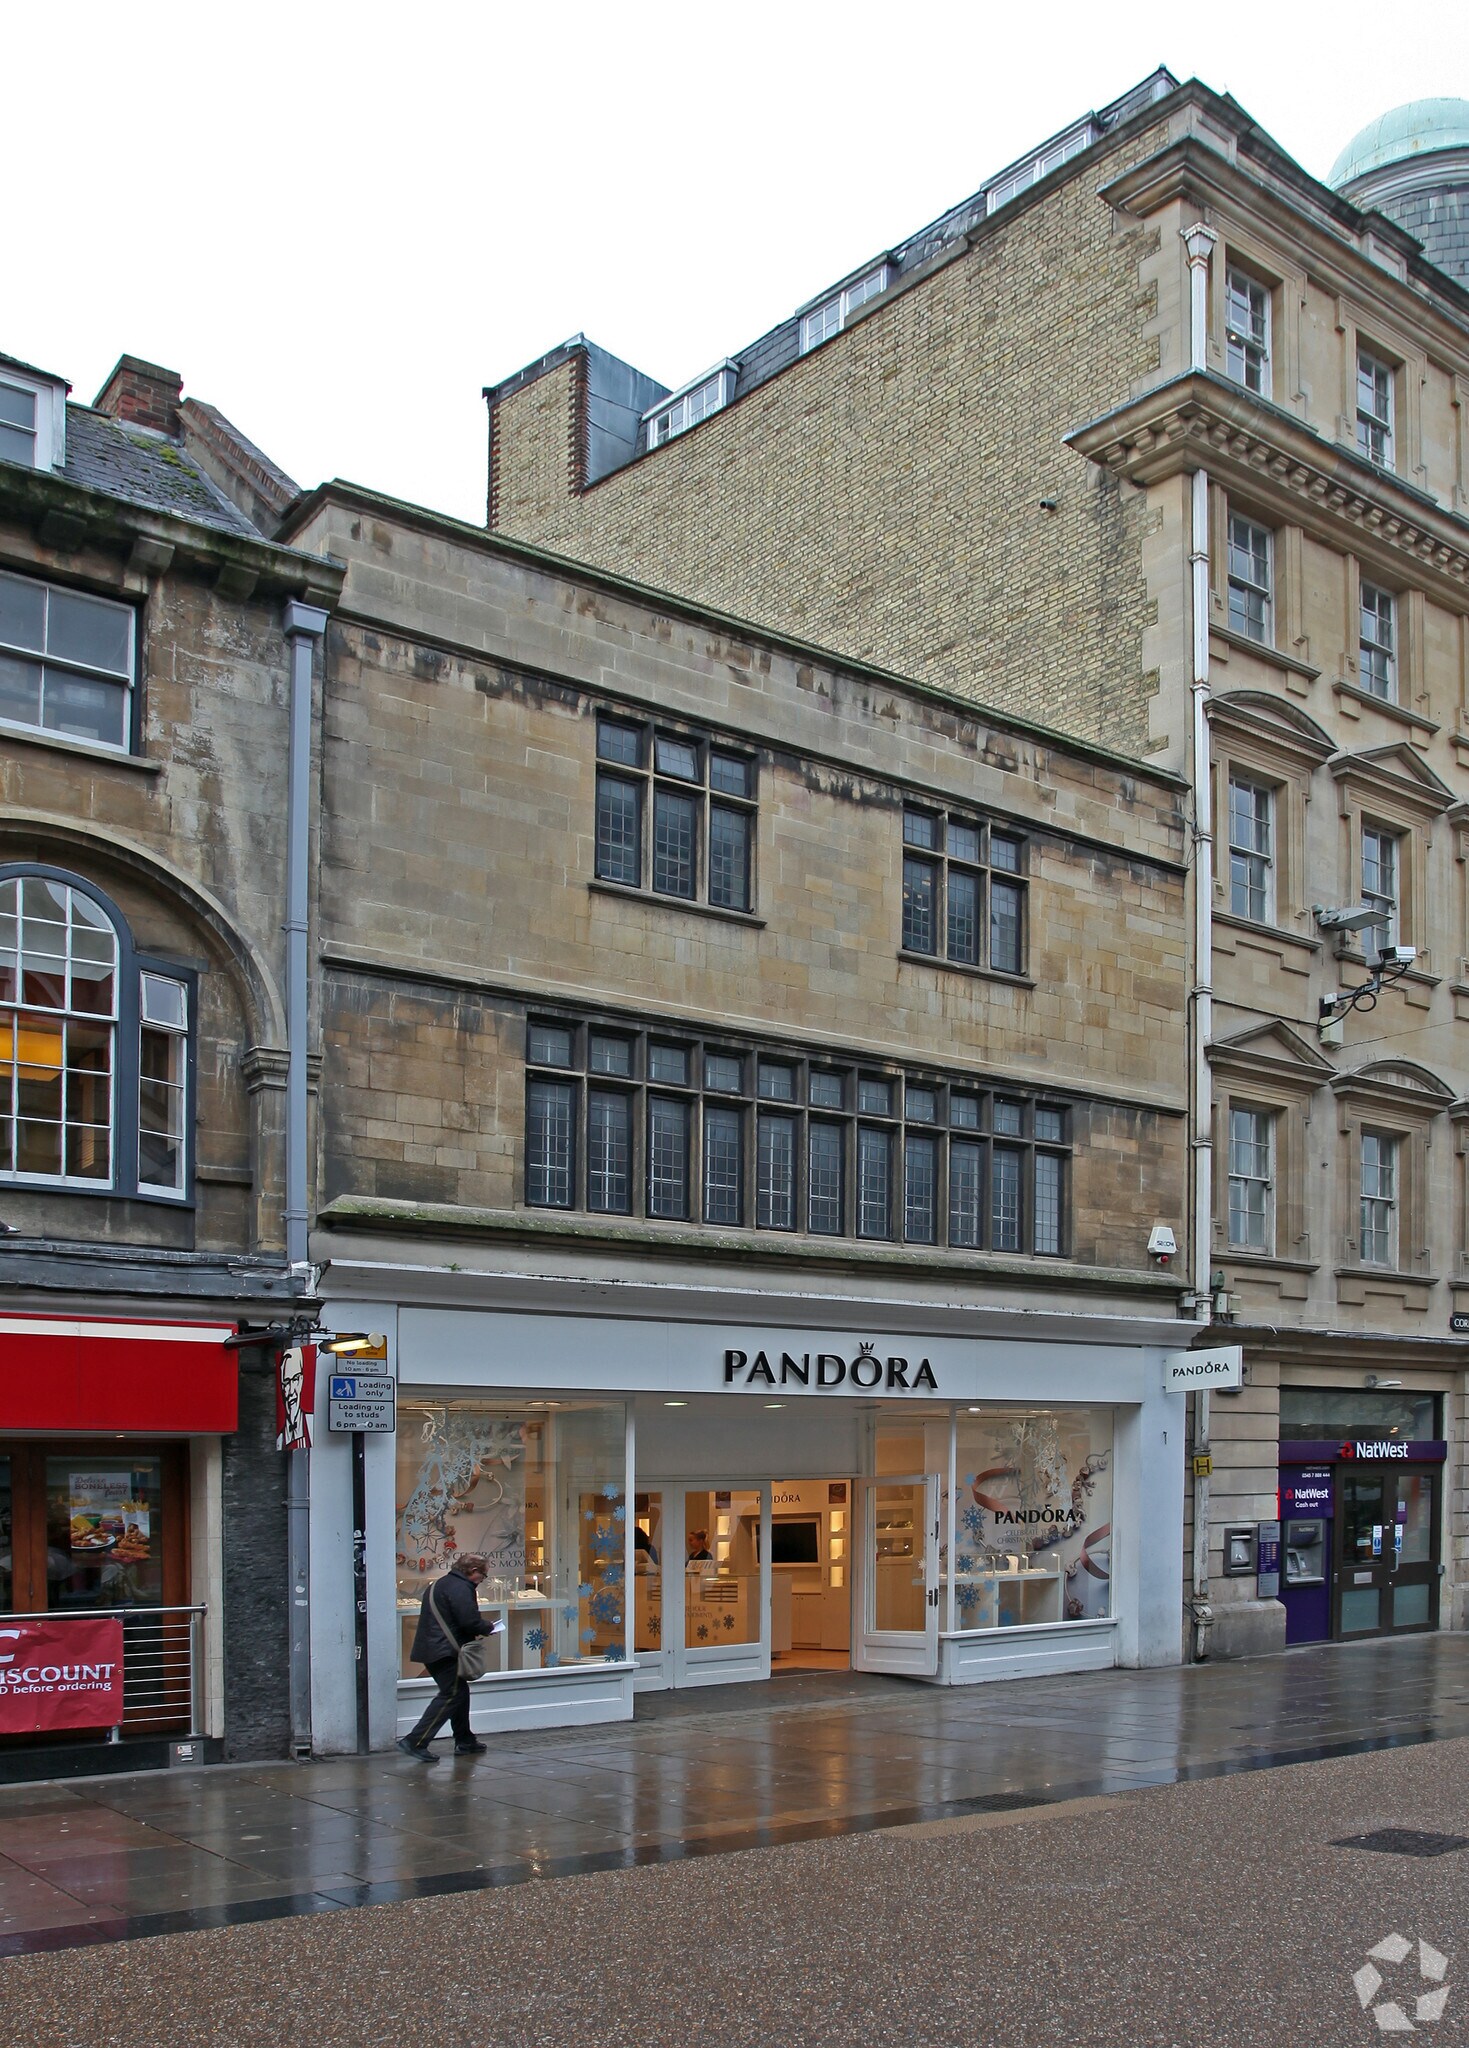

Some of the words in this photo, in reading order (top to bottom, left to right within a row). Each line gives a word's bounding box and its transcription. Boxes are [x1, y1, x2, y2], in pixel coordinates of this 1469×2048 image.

[724, 1349, 939, 1389] PANDORA
[1172, 1362, 1230, 1378] PANDORA
[358, 1382, 392, 1391] Loading
[338, 1403, 372, 1411] Loading
[336, 1420, 342, 1428] 6
[1356, 1441, 1409, 1459] NatWest
[1196, 1458, 1210, 1475] H
[74, 1482, 129, 1491] BONELESS
[756, 1493, 801, 1504] PDORA
[1294, 1488, 1329, 1499] NatWest
[995, 1509, 1077, 1525] PANDORA
[13, 1683, 54, 1695] before
[57, 1681, 112, 1692] ordering
